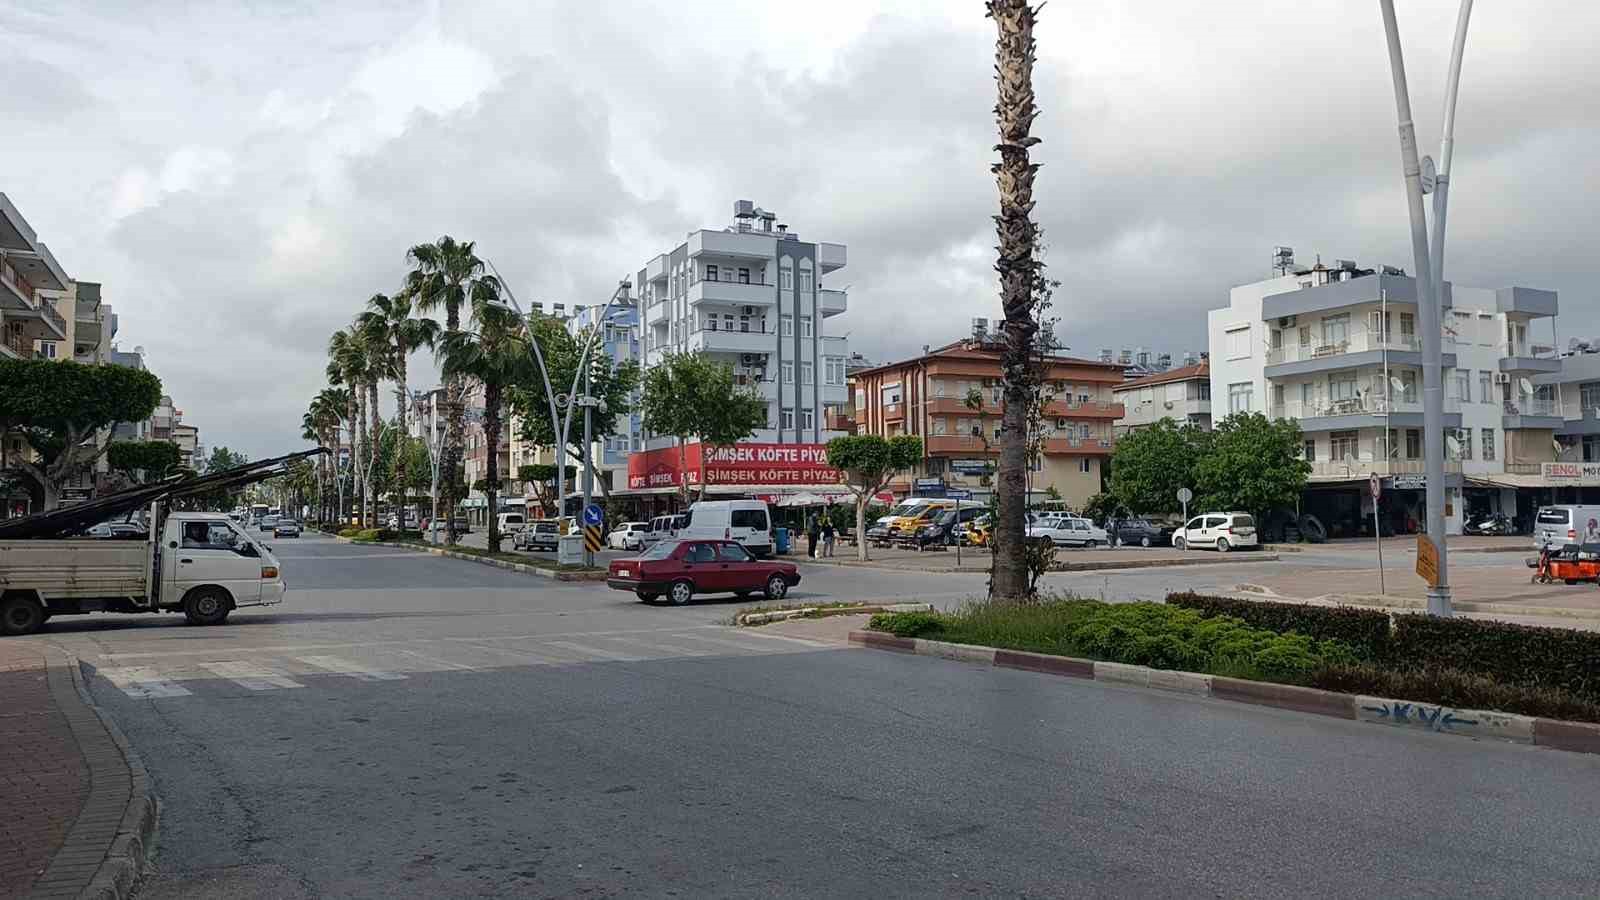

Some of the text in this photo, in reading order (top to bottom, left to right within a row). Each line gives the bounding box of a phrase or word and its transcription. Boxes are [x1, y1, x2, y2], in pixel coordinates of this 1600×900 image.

[704, 446, 828, 464] ŞİMŞEK KÖFTE PİYA
[706, 468, 837, 482] ŞİMŞEK KÖFTE PİYAZ
